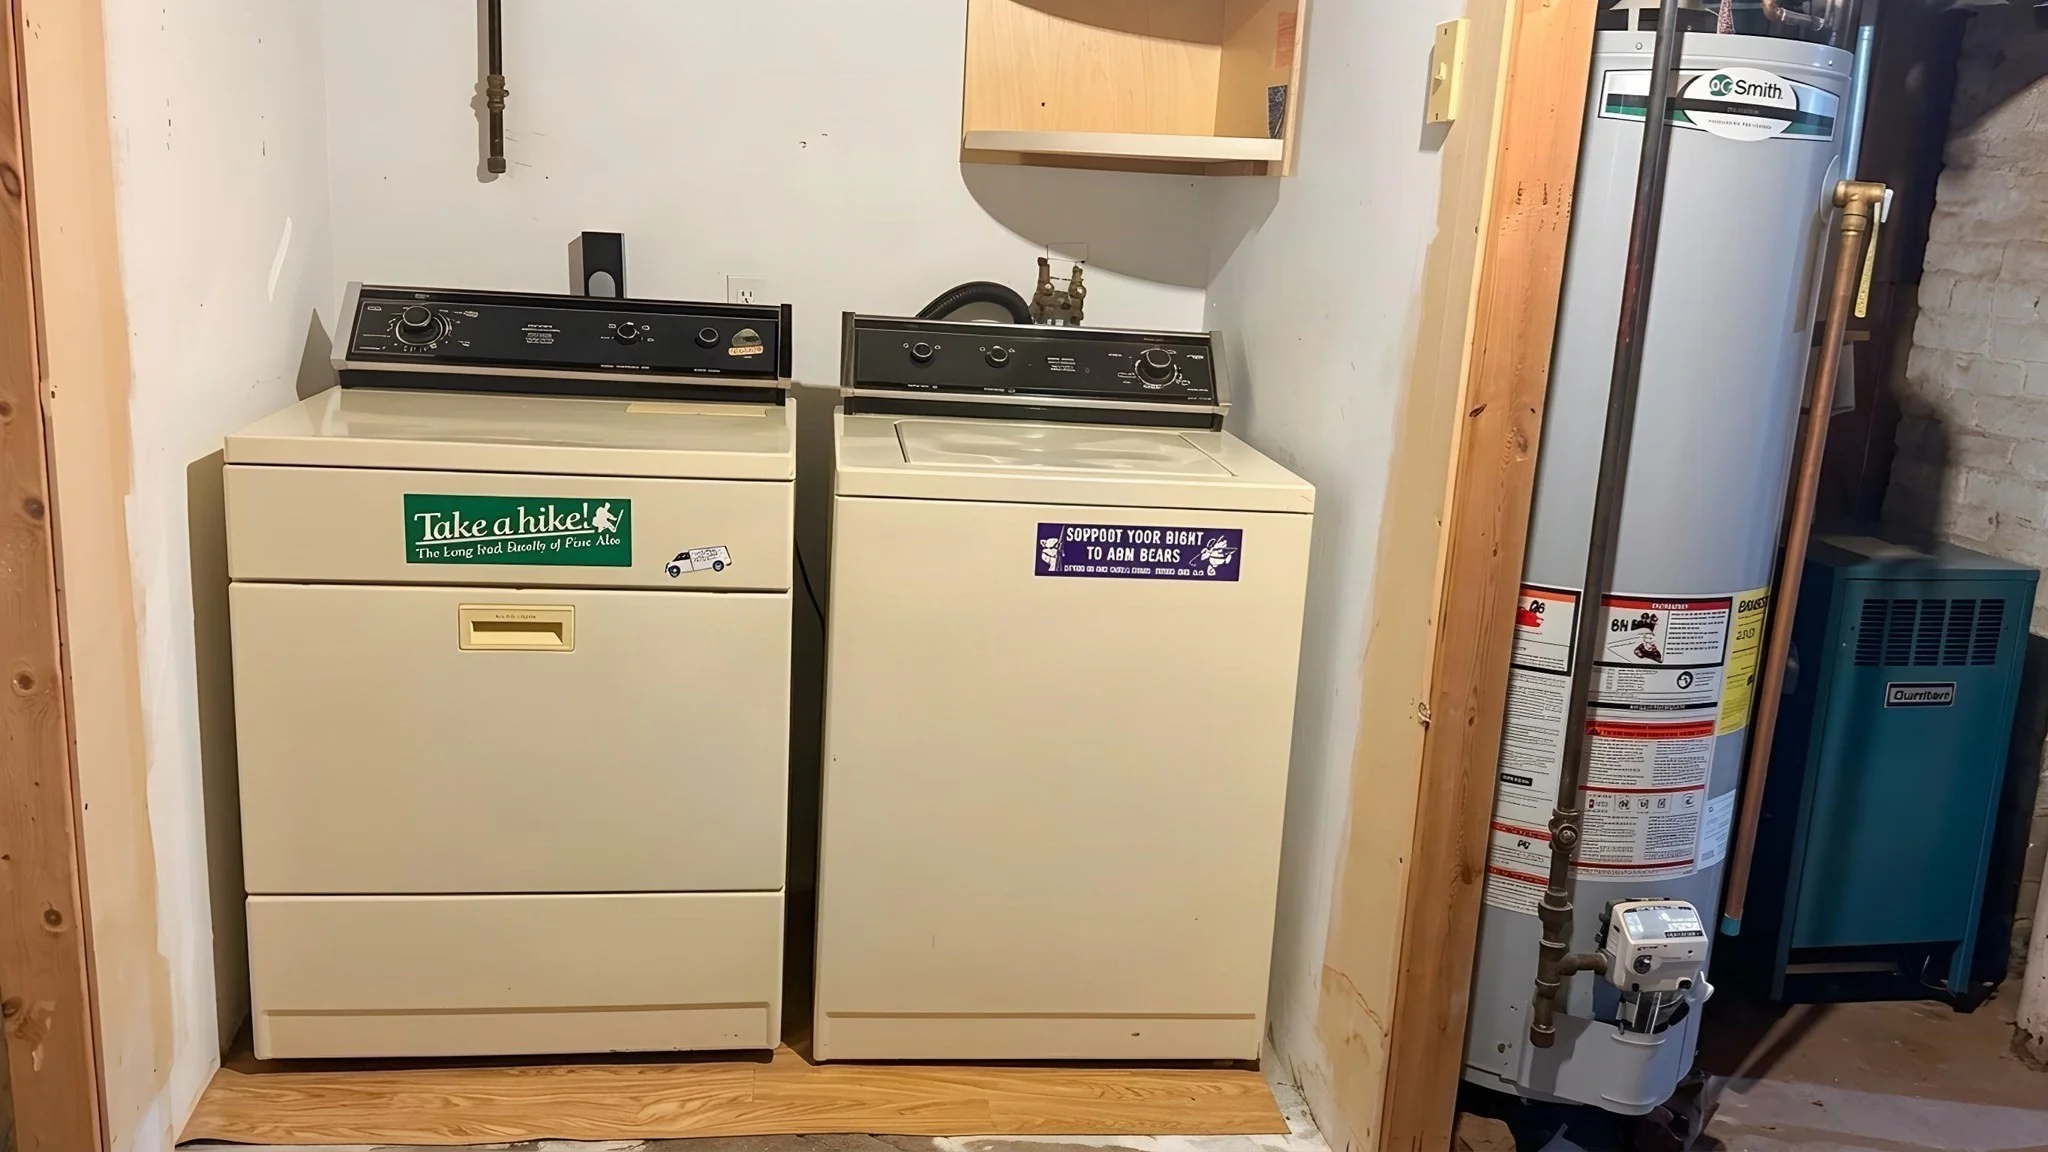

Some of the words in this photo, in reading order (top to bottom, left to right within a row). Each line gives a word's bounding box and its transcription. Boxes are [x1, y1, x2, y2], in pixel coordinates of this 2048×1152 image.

[414, 511, 488, 541] Take
[493, 517, 514, 535] a
[517, 503, 591, 534] hike!
[1086, 546, 1102, 560] TO
[1140, 548, 1181, 563] BEARS
